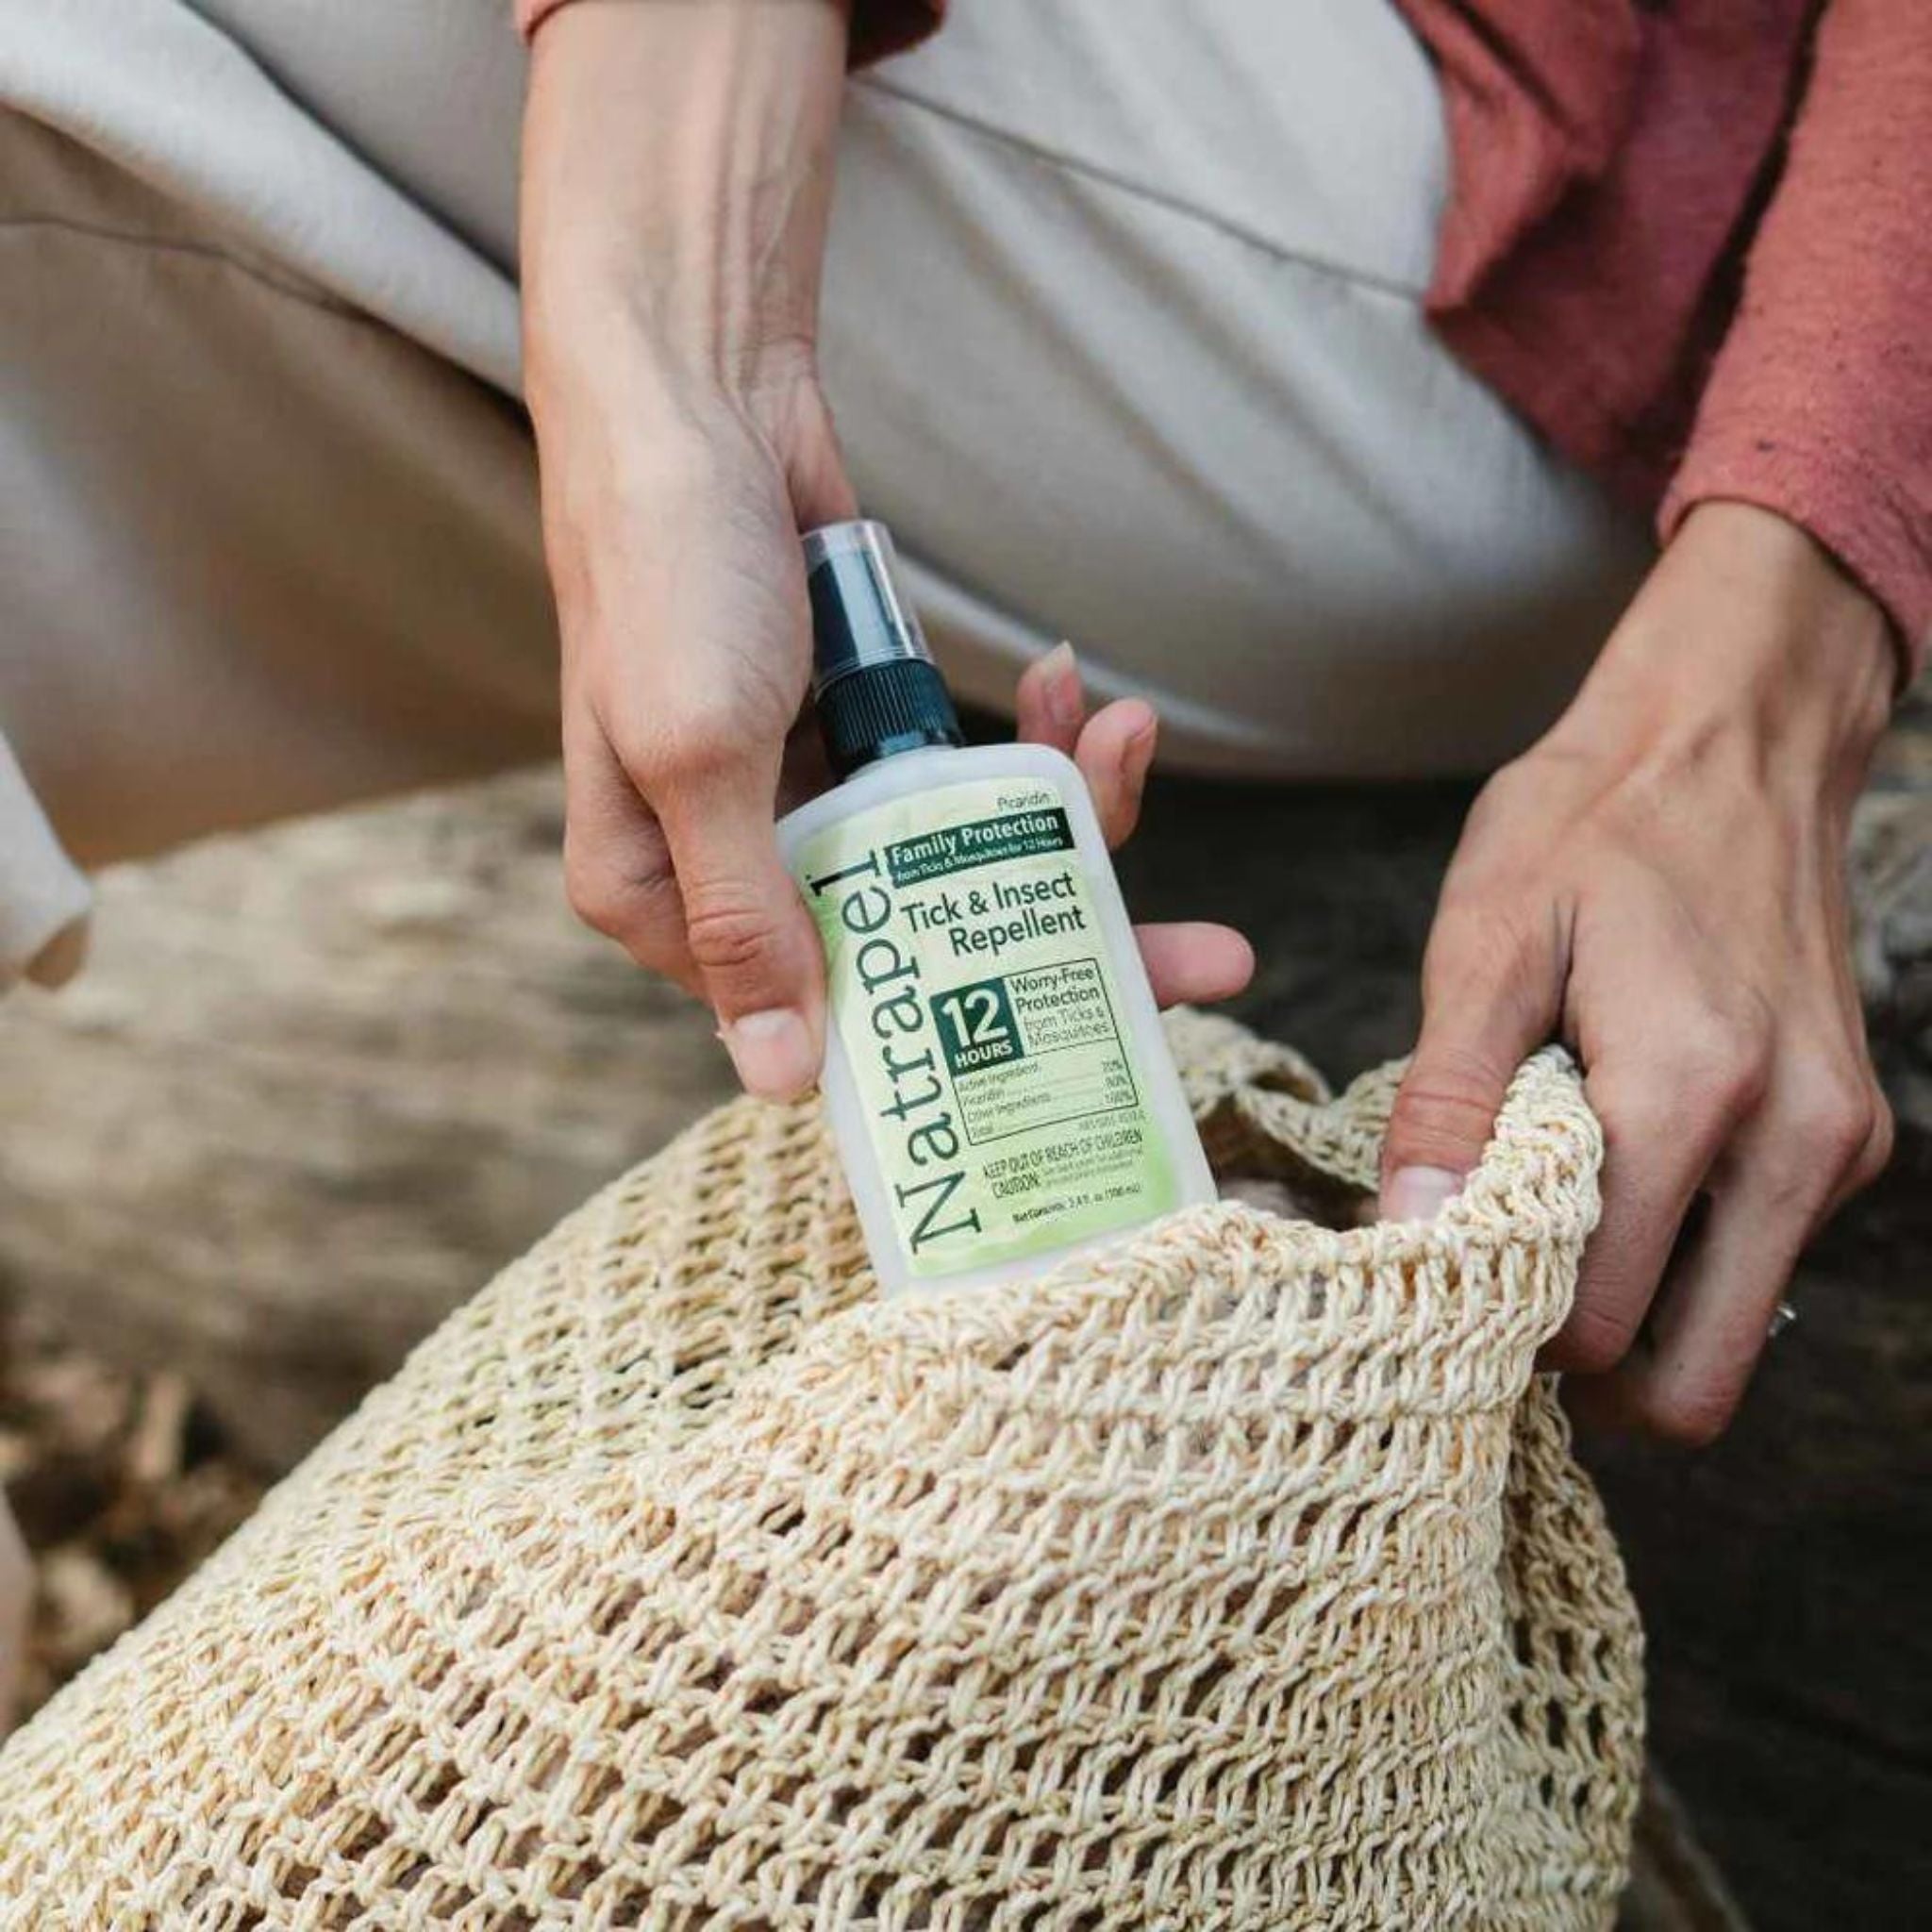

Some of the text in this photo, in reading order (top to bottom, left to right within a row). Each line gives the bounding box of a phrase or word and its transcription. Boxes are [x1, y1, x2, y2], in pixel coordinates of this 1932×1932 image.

[891, 814, 1058, 865] Family Protection
[897, 866, 920, 881] from
[944, 858, 953, 869] &
[900, 873, 1076, 933] Tick & Insect
[949, 906, 1086, 957] Repellent
[1010, 967, 1094, 993] Worry-Free
[1015, 986, 1100, 1013] Protection
[941, 989, 1008, 1048] 12
[1024, 1013, 1058, 1030] from
[1059, 1007, 1094, 1024] Ticks
[1028, 1021, 1108, 1047] Mosquitoes
[809, 850, 982, 1256] Natrapel
[955, 1040, 1013, 1068] HOURS
[983, 1158, 1007, 1179] KEEP
[1008, 1153, 1029, 1174] OUT
[1029, 1148, 1043, 1167] OF
[1045, 1141, 1078, 1162] REACH
[1079, 1138, 1092, 1154] OF
[1095, 1128, 1143, 1151] CHILDREN
